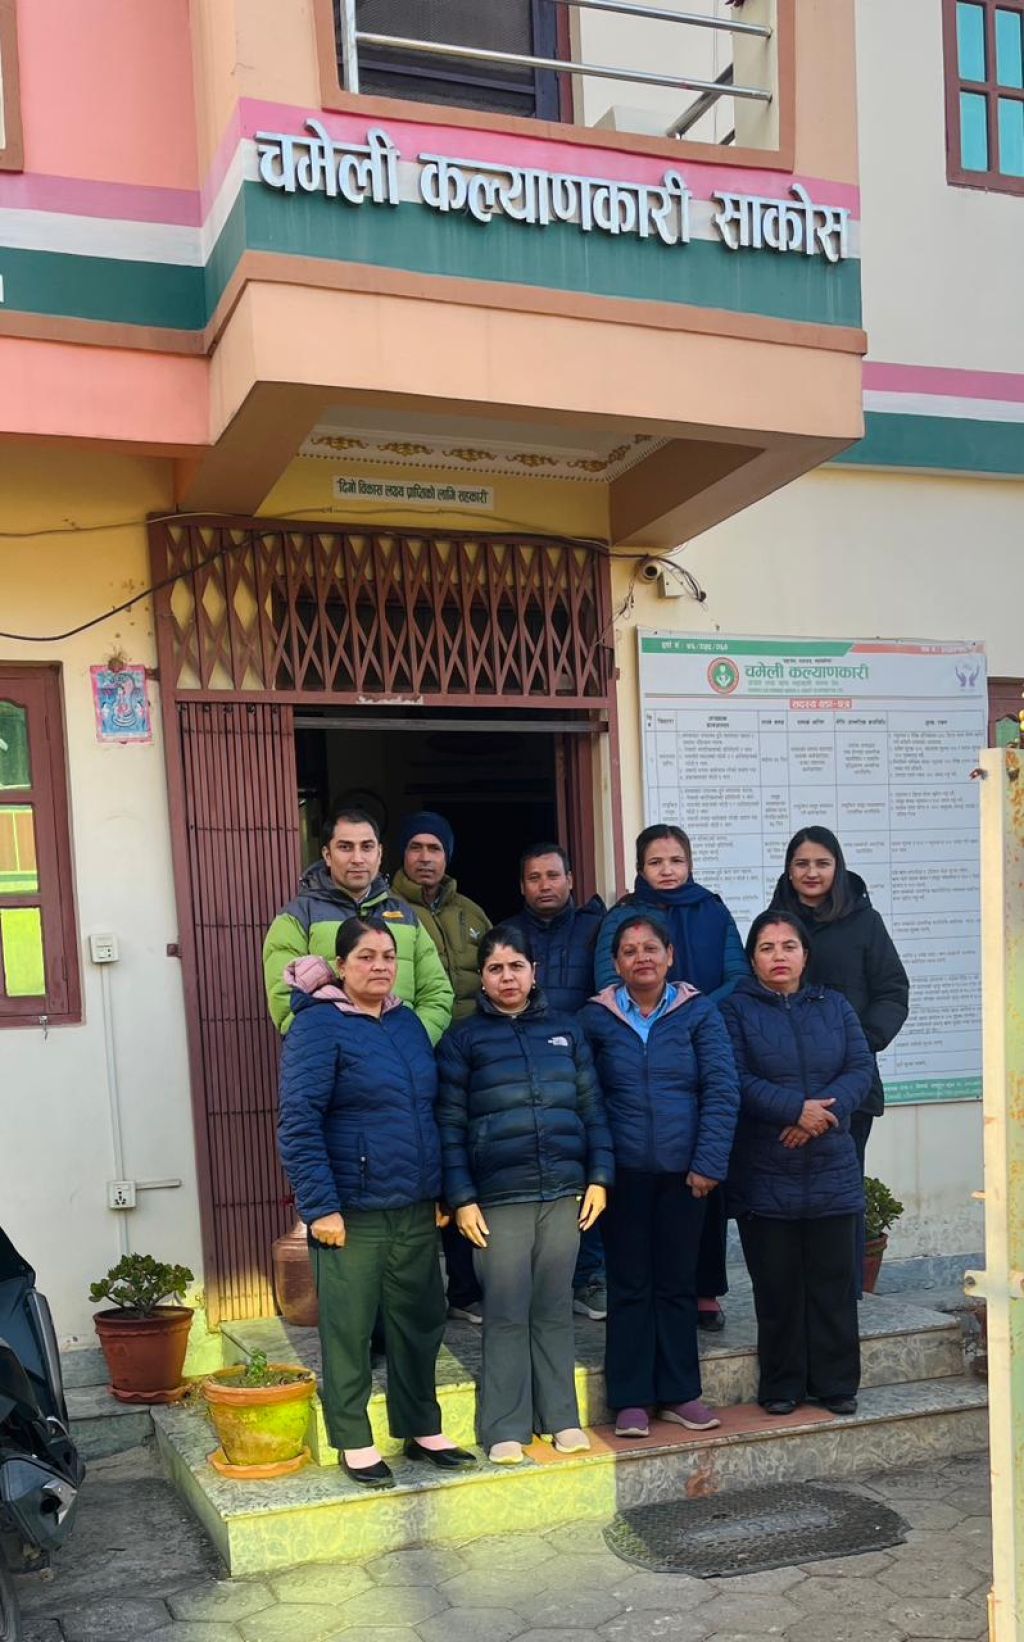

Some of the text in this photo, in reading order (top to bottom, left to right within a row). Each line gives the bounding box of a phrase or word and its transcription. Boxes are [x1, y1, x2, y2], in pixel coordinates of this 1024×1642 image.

[255, 118, 850, 263] चमेली कल्याणकारी साकोस
[744, 661, 869, 680] चमेली कल्याणकारी
